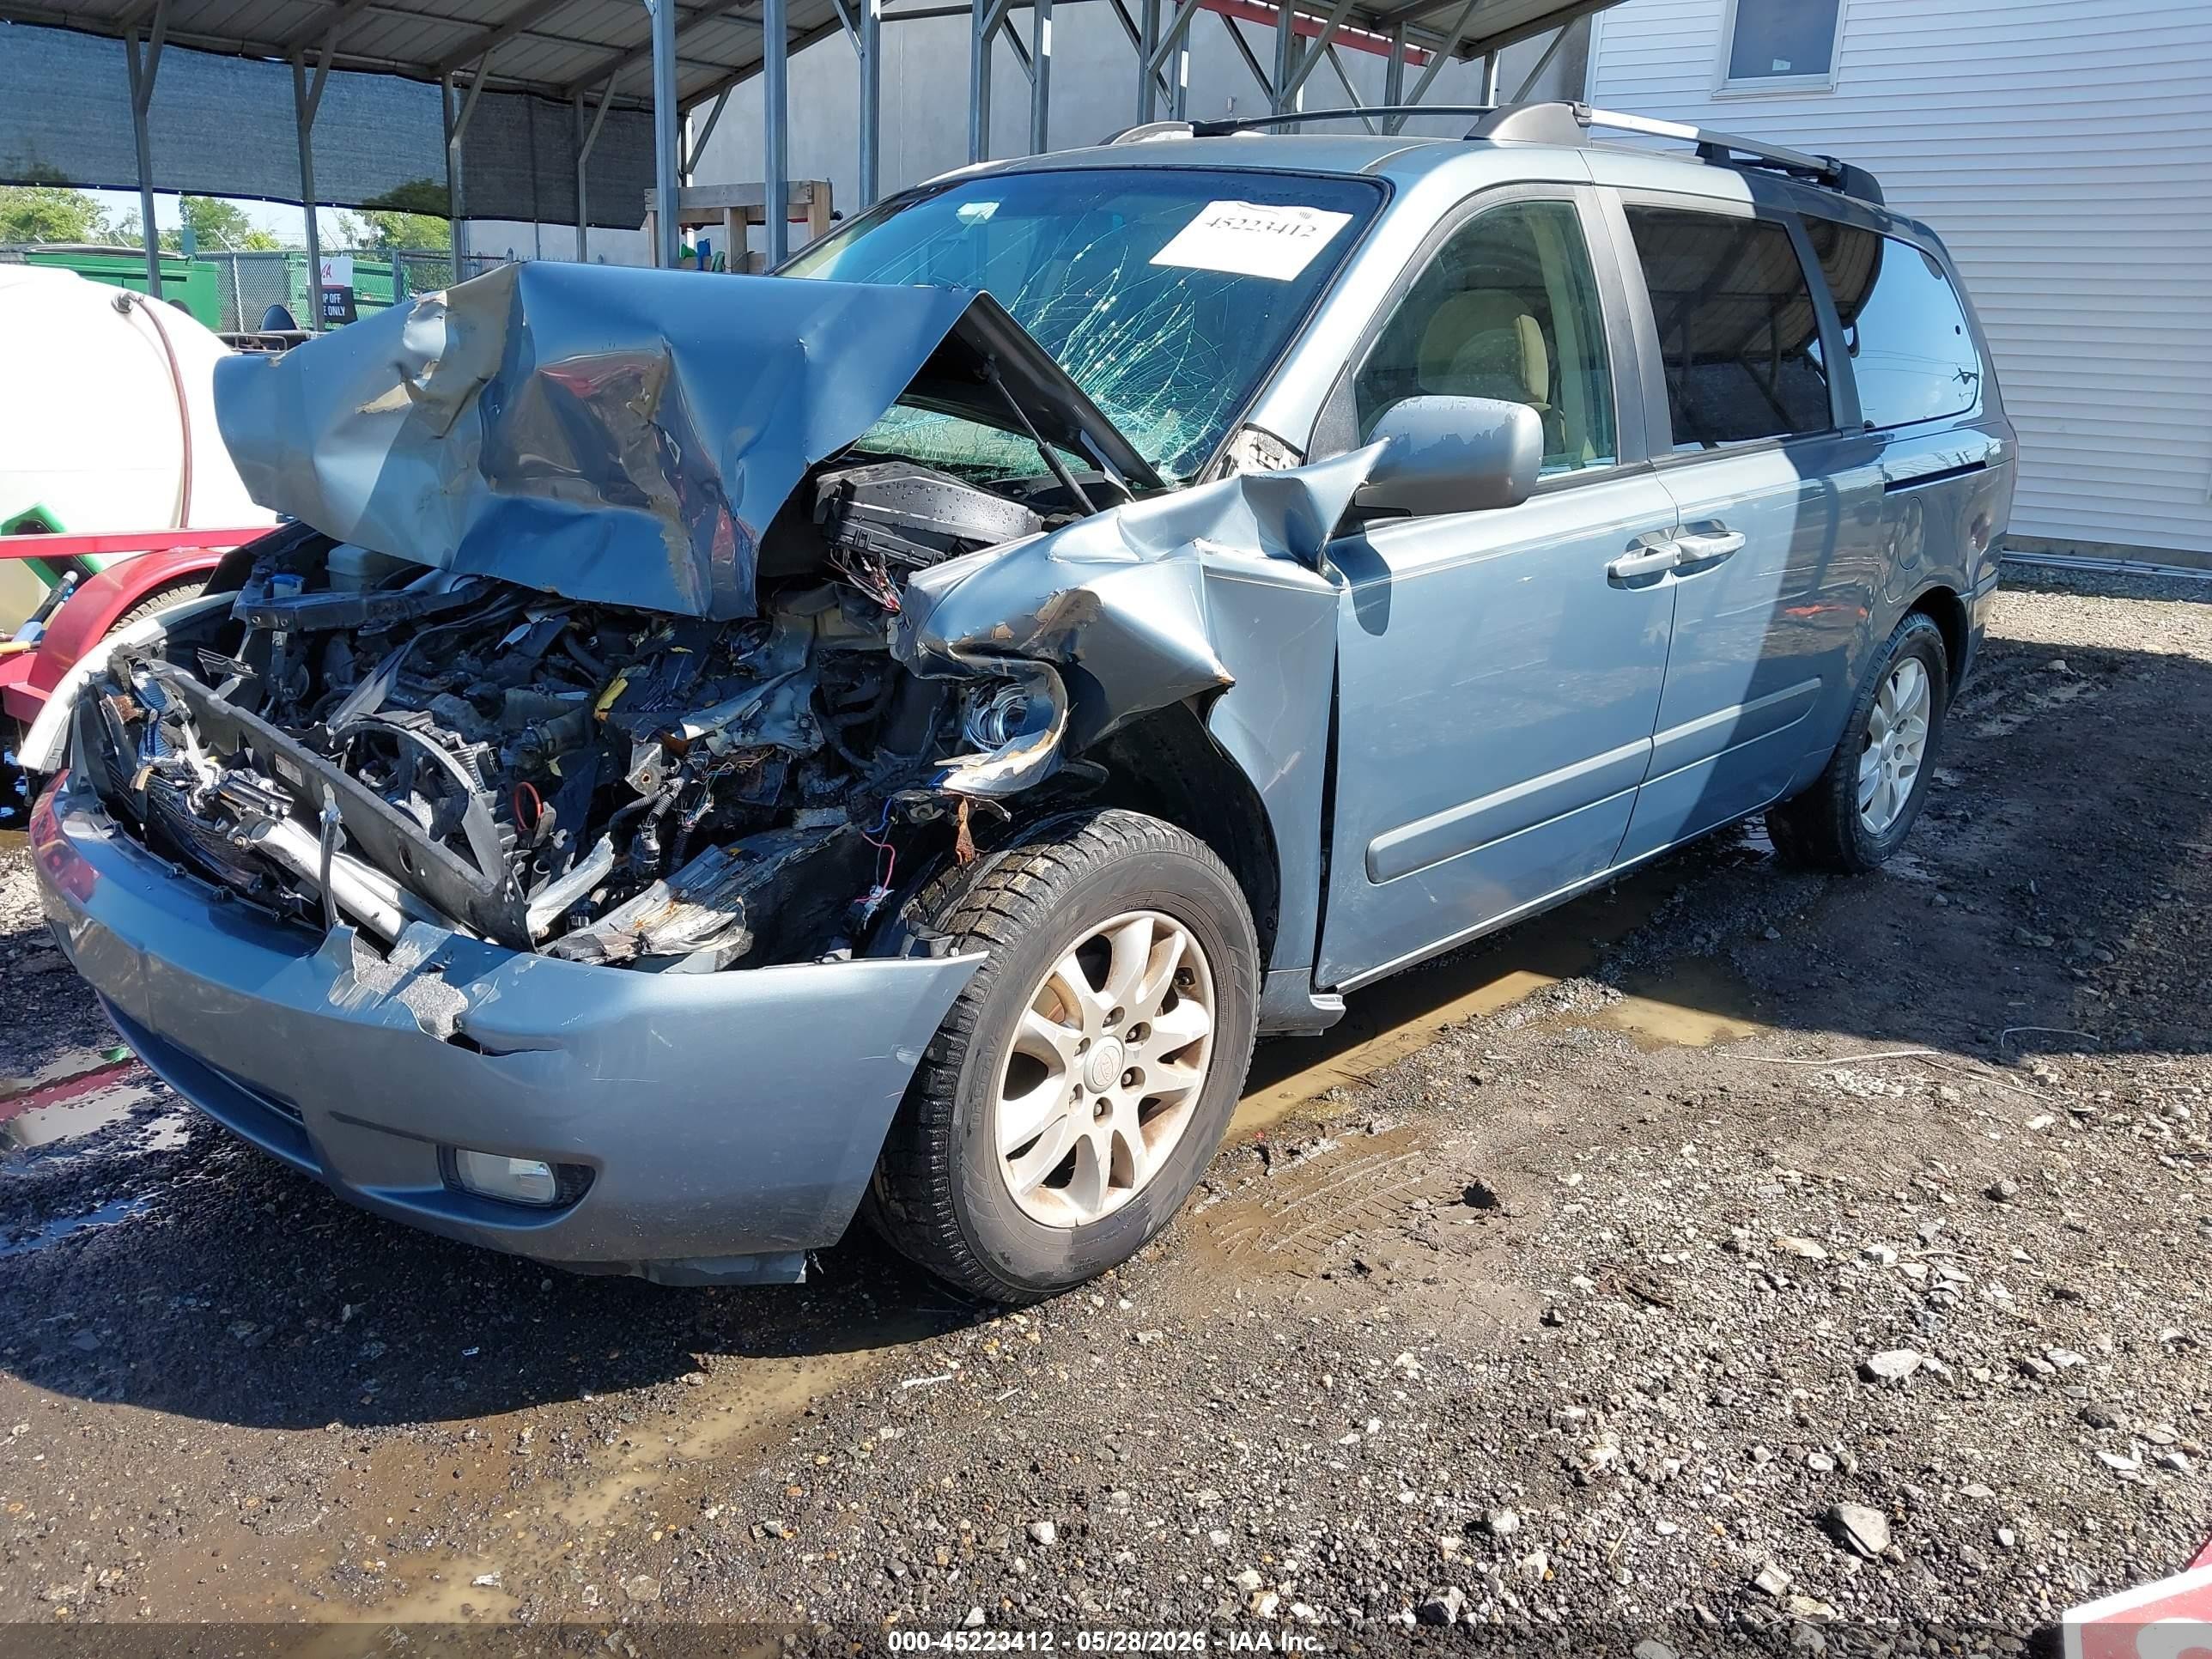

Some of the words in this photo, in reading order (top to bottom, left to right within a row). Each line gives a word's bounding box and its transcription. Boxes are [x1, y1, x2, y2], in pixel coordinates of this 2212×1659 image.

[1205, 216, 1317, 238] 45223412
[329, 293, 342, 304] OFF
[328, 306, 345, 317] ONLY
